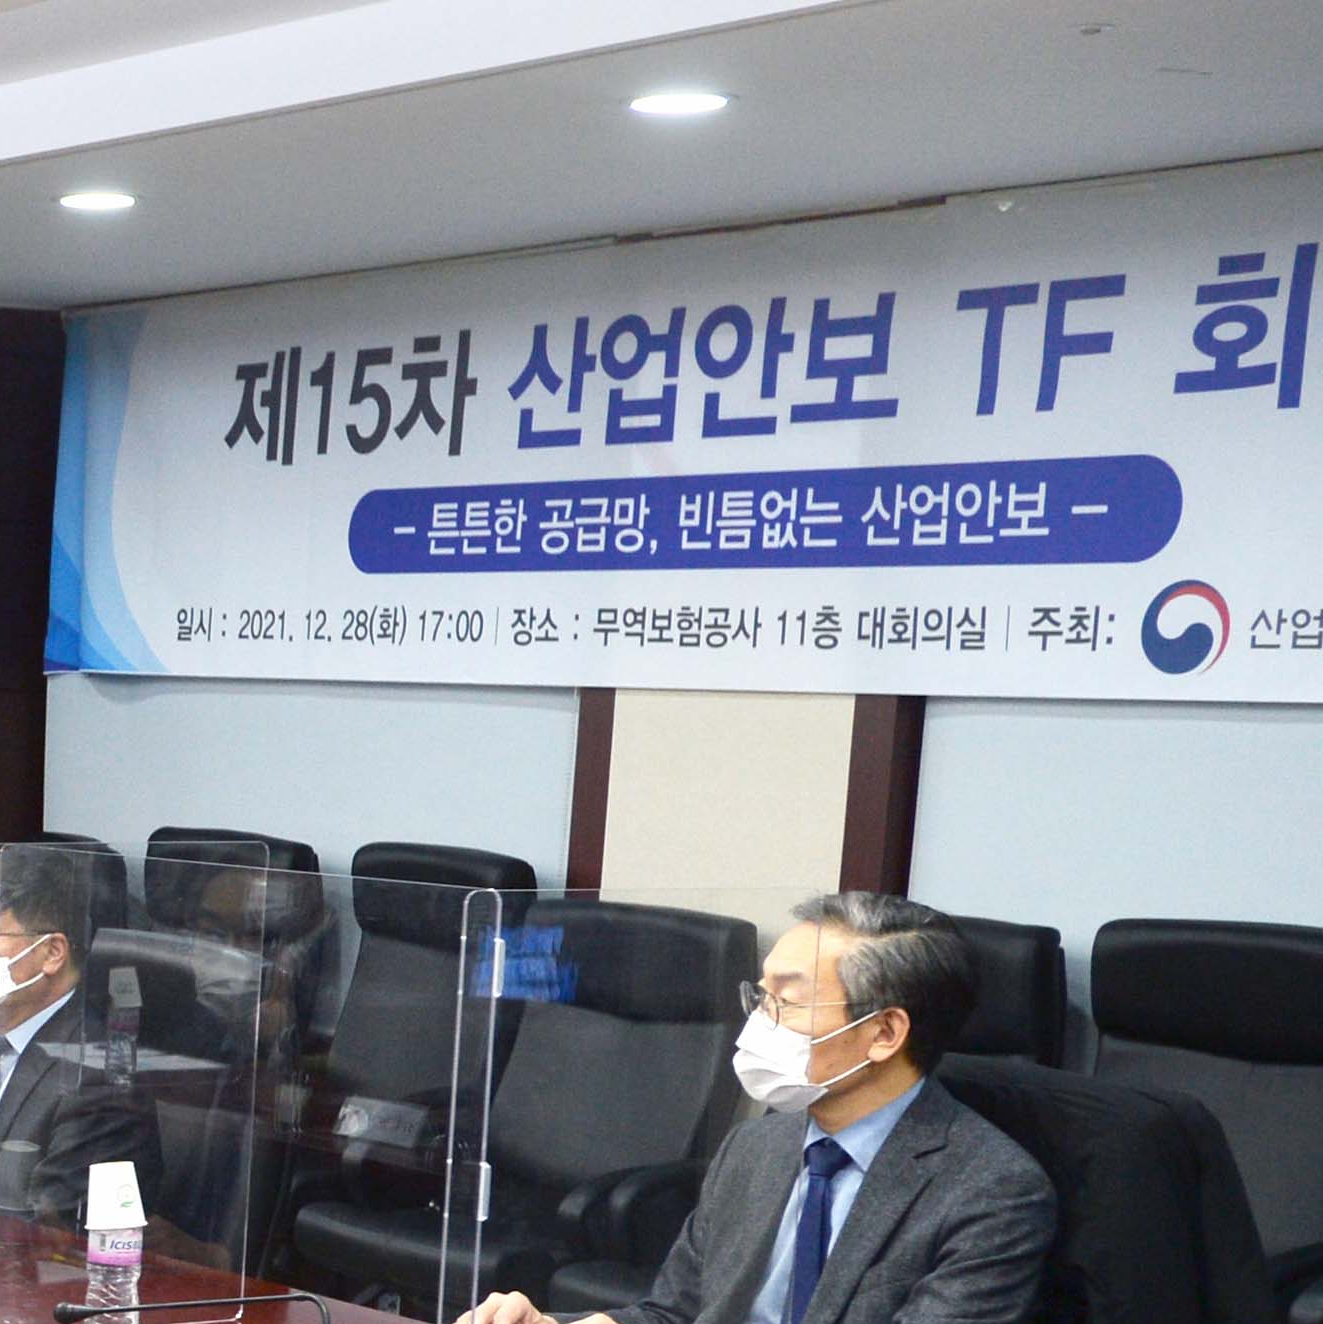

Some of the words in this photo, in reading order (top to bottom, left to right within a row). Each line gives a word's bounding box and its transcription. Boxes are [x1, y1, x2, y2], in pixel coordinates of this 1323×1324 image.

[224, 329, 478, 465] 제15차
[507, 292, 899, 449] 산업안보
[956, 274, 1127, 416] TF
[1174, 243, 1320, 410] 회
[427, 498, 528, 555] 튼튼한
[539, 493, 658, 555] 공급망,
[679, 487, 843, 550] 빈틈없는
[861, 480, 1050, 546] 산업안보
[237, 608, 294, 642] 2021.
[305, 608, 333, 642] 12.
[341, 604, 407, 646] 28(화)
[418, 609, 484, 643] 17:00
[593, 605, 762, 648] 무역보험공사
[777, 604, 843, 650] 11층
[857, 605, 987, 651] 대회의실
[1027, 604, 1116, 651] 주최:
[1250, 608, 1323, 650] 산업
